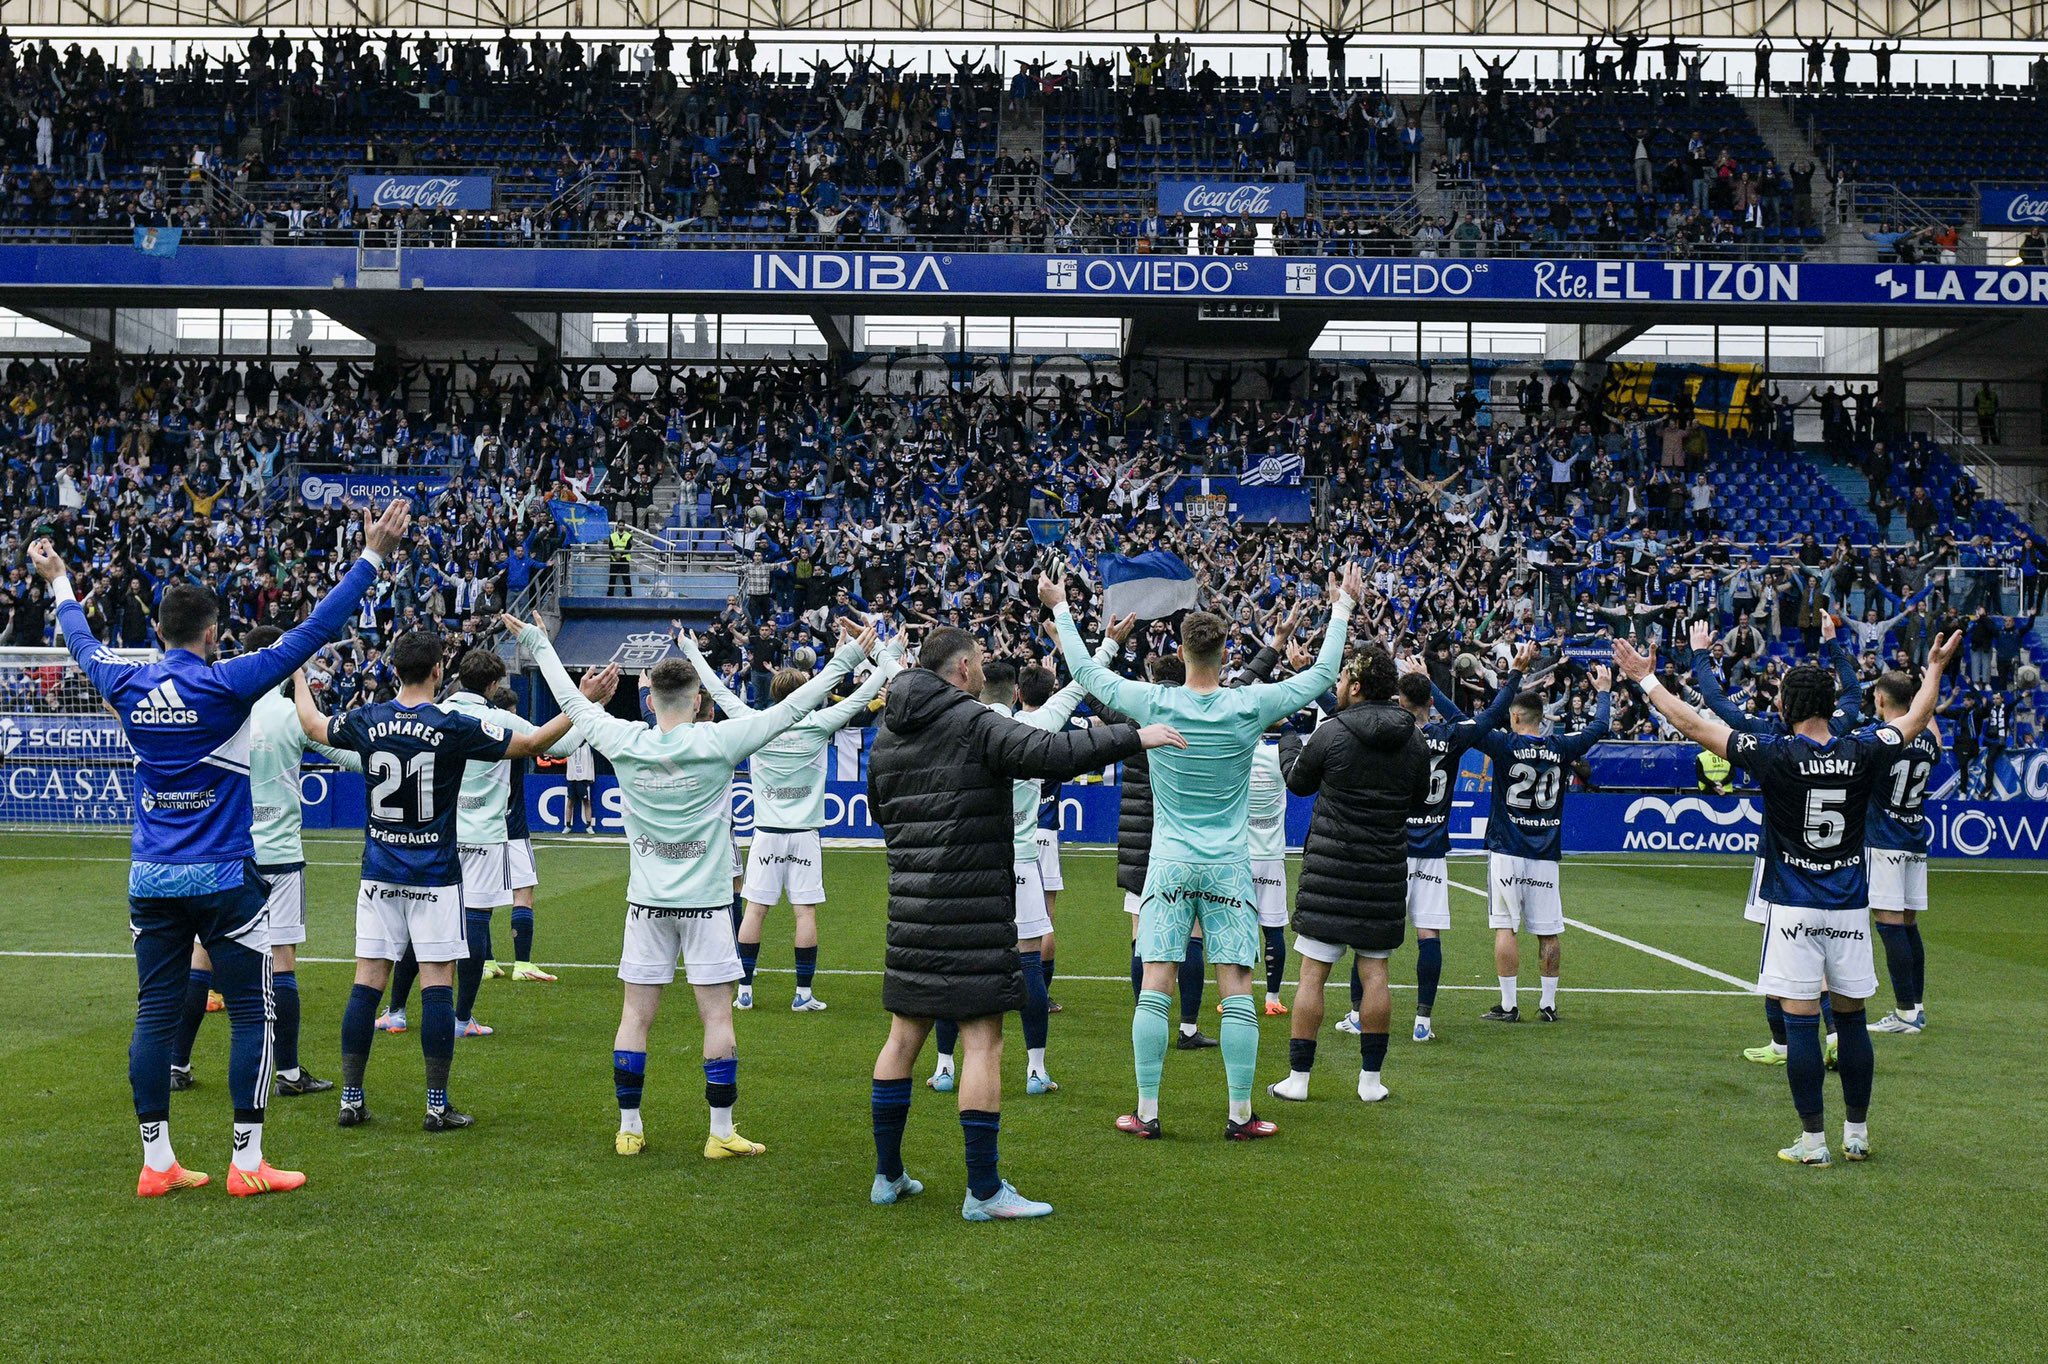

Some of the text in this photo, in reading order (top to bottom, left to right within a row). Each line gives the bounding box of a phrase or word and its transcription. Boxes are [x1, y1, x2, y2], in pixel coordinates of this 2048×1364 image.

[1534, 261, 1593, 298] Rte.
[1596, 262, 1650, 299] EL
[1915, 269, 1965, 300] LA
[350, 485, 391, 496] GRUPO
[130, 707, 198, 724] adidas
[368, 721, 444, 747] POMARES
[1513, 749, 1537, 761] HUGO
[1799, 759, 1857, 777] LUISMI
[9, 768, 128, 800] CASA
[369, 751, 436, 823] 21
[1506, 762, 1561, 810] 20
[1890, 760, 1931, 809] 12
[156, 789, 216, 801] SCIENTIFFIC
[1803, 788, 1847, 850] 5
[408, 832, 439, 844] Auto
[1782, 851, 1832, 871] Tartiere
[380, 889, 439, 903] FanSports
[1182, 889, 1242, 909] FanSports
[1804, 926, 1865, 940] FanSports
